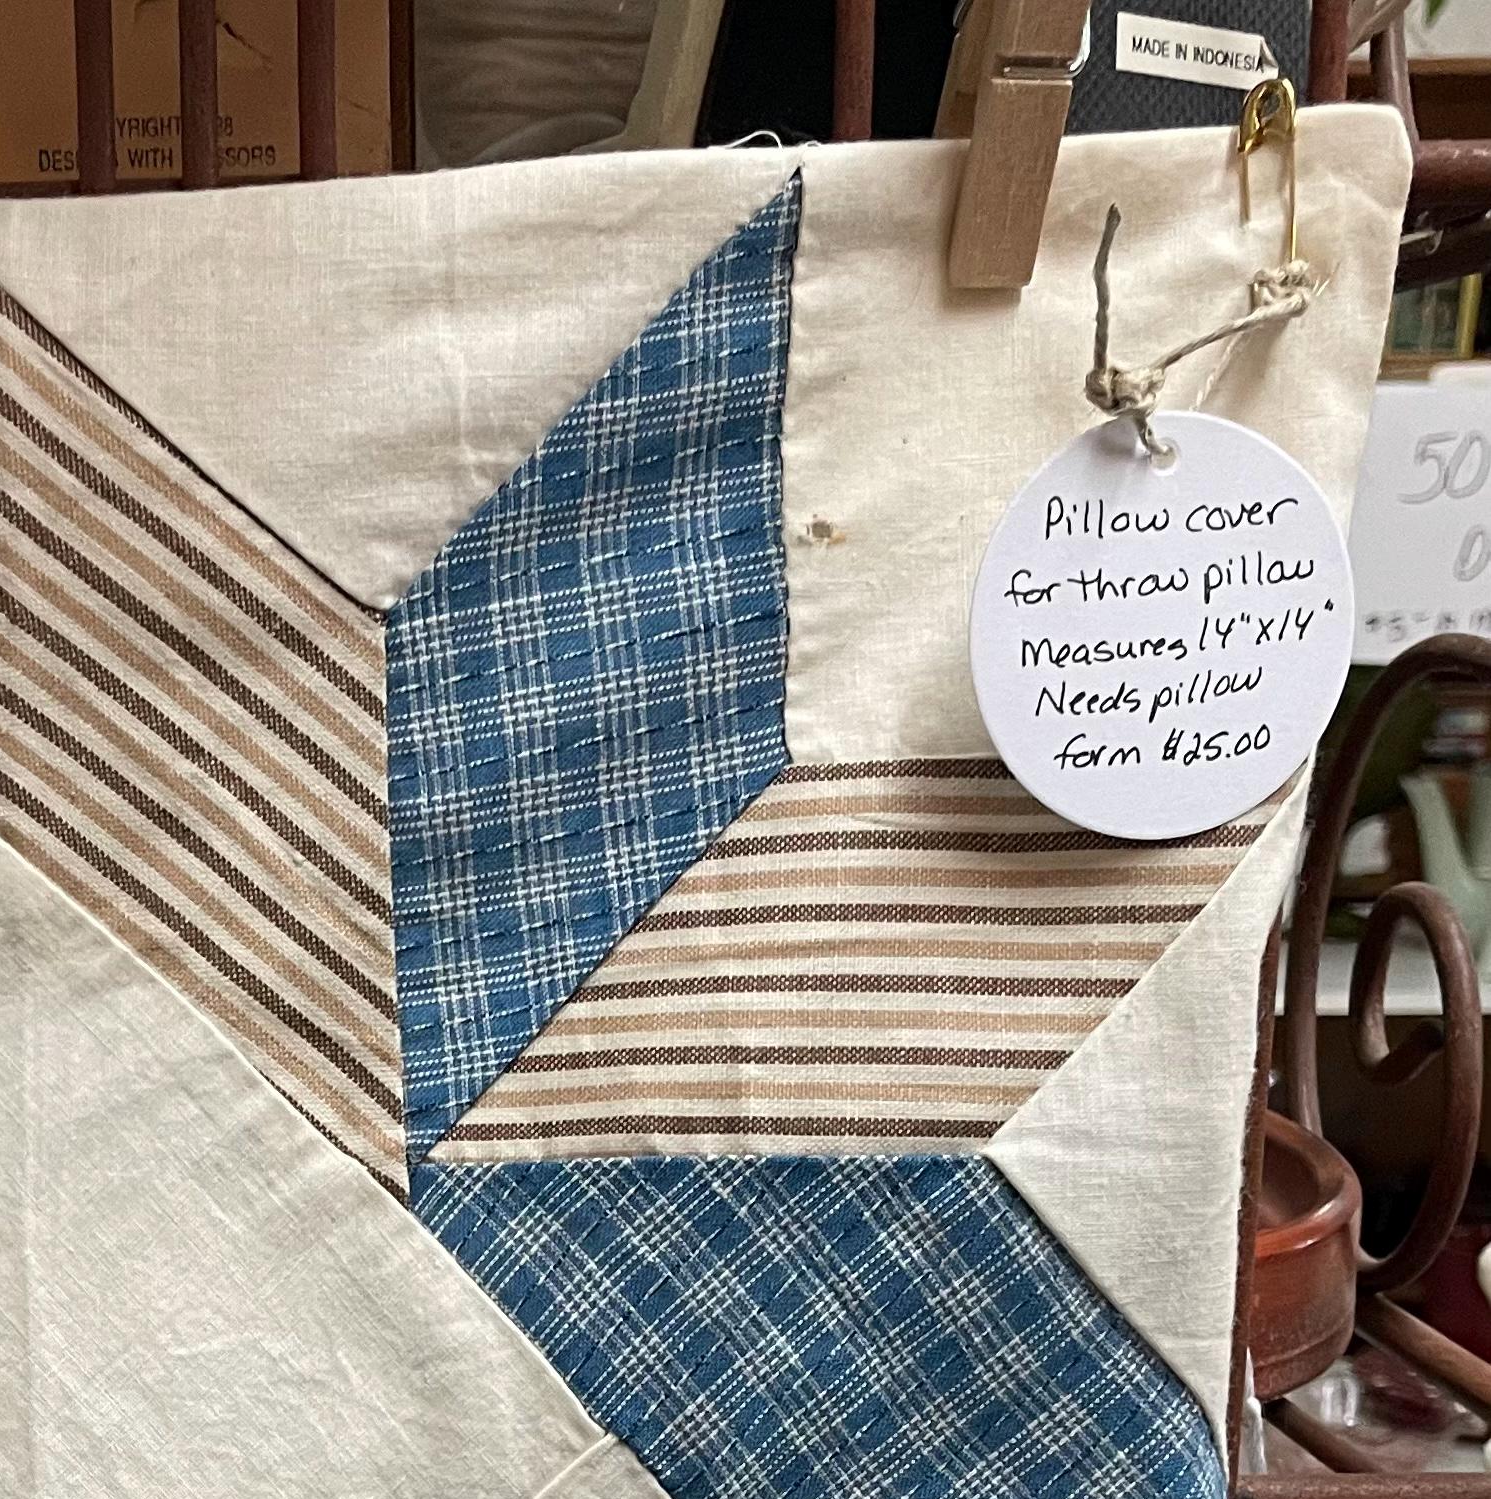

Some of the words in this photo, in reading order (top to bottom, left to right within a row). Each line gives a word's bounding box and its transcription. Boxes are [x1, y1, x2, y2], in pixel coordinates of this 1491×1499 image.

[1132, 35, 1170, 57] MADE
[1175, 43, 1188, 61] IN
[1193, 46, 1264, 73] INDONESIA
[116, 117, 181, 138] YRIGHT
[128, 147, 173, 169] WITH
[216, 145, 277, 169] SSORS
[1045, 496, 1170, 540] Pillow
[1185, 498, 1299, 533] cover
[1004, 569, 1061, 607] for
[1067, 568, 1189, 601] throw
[1203, 551, 1315, 604] pillow
[1035, 681, 1142, 716] Needs
[1148, 667, 1262, 723] pillow
[1053, 733, 1141, 770] form
[1162, 724, 1271, 766] $25.00
